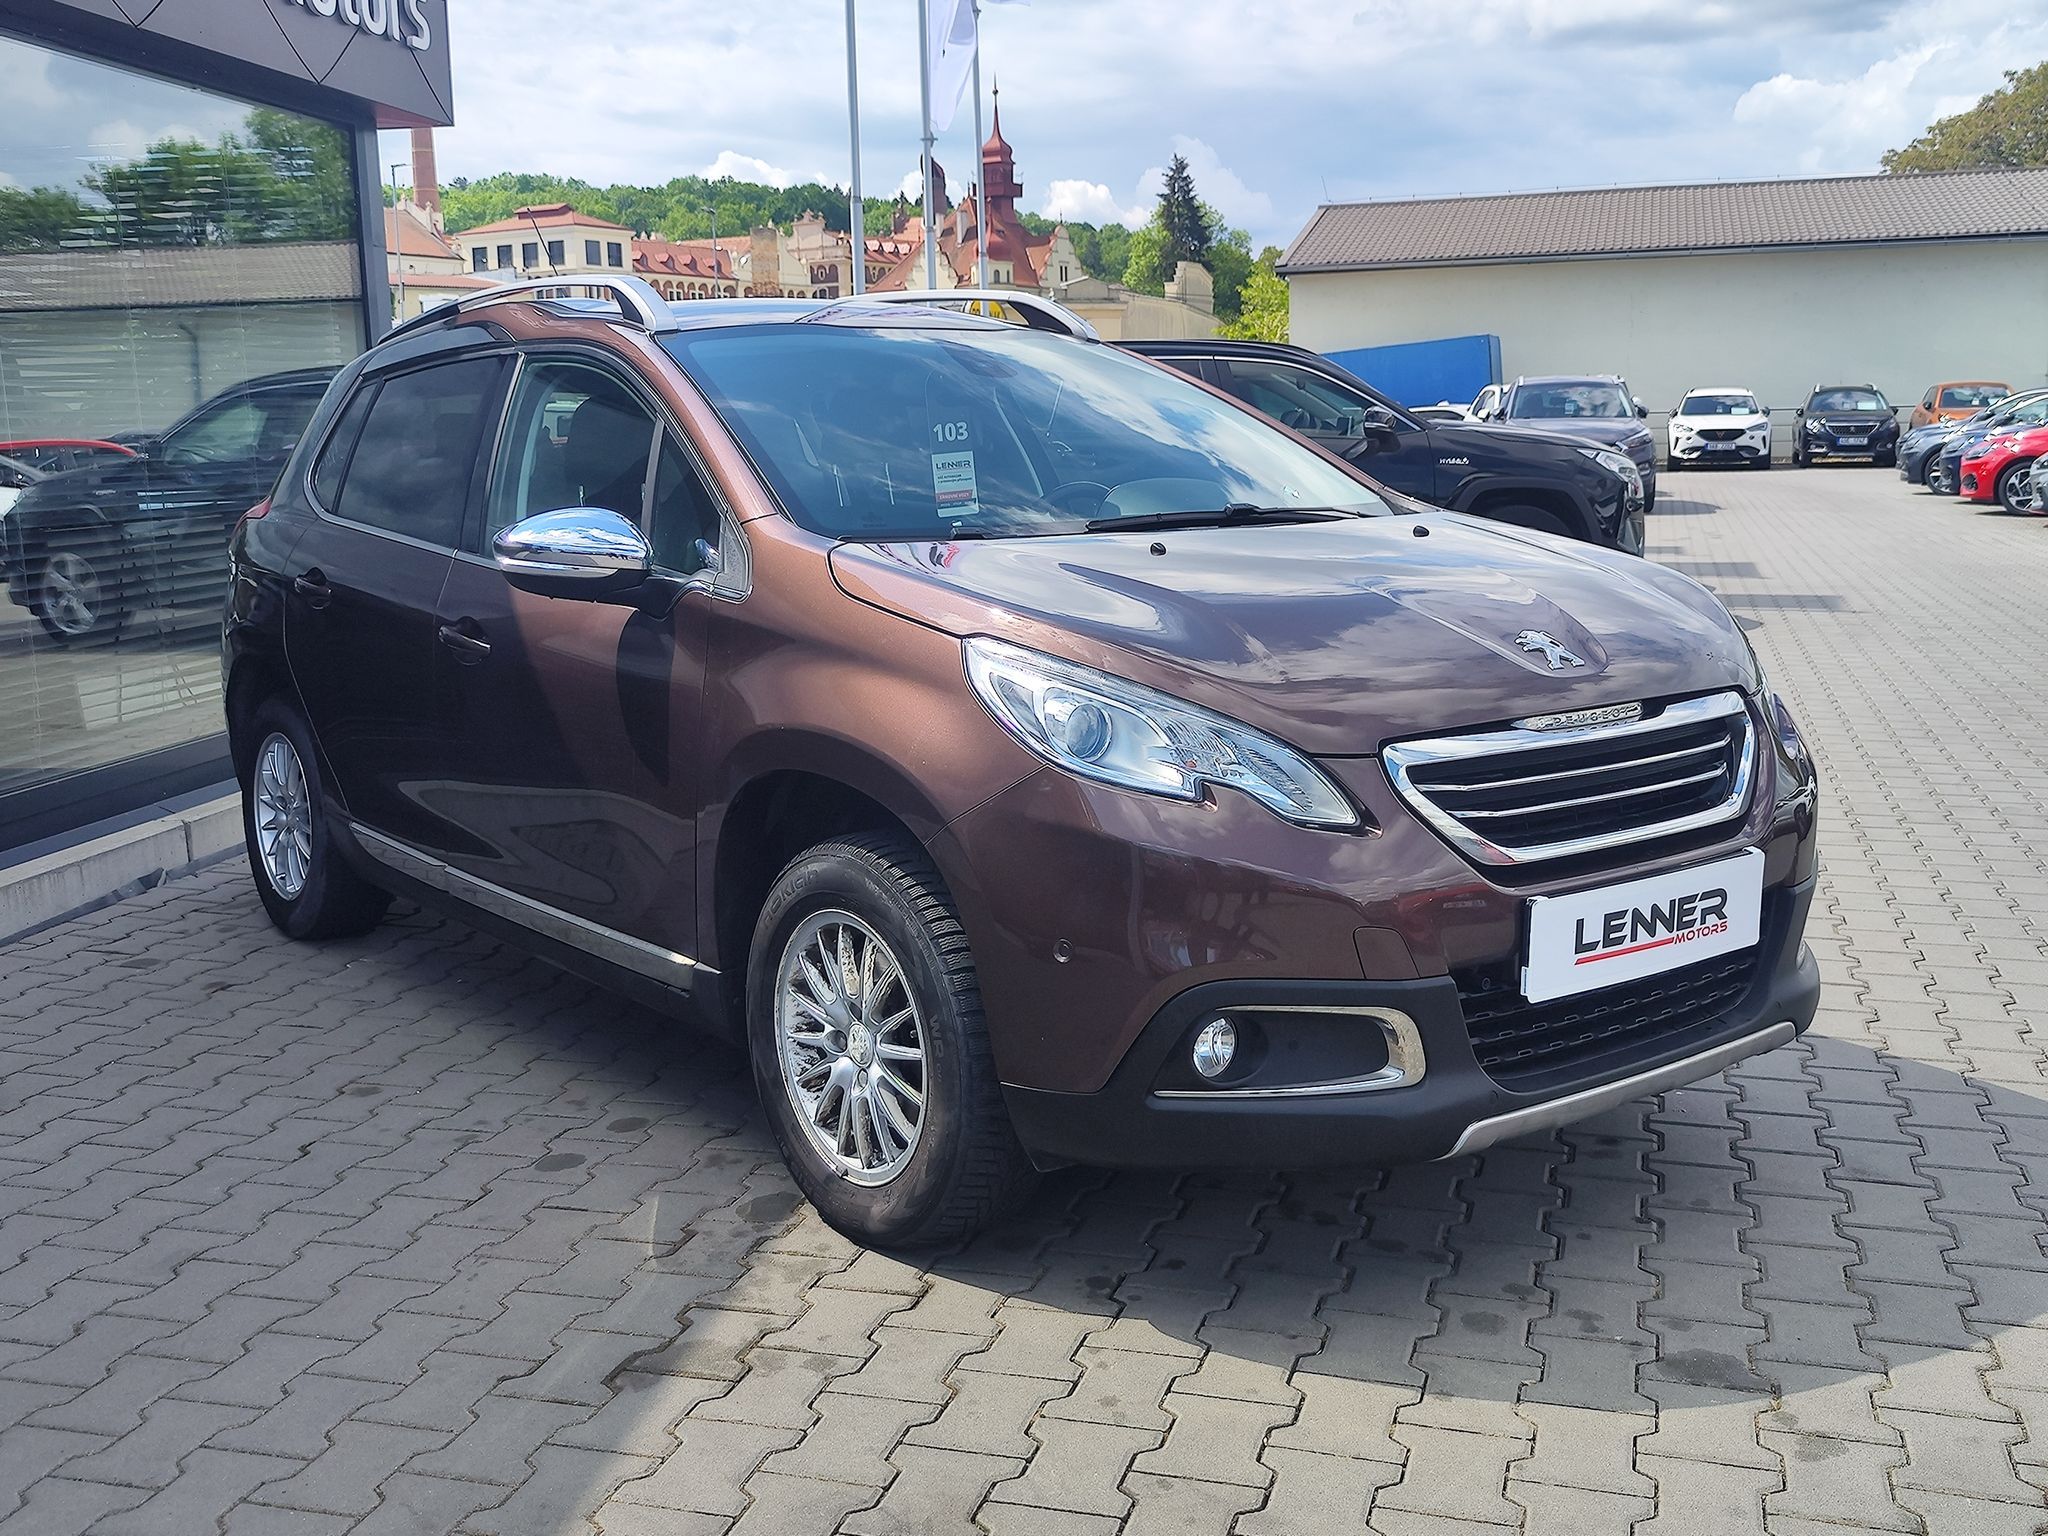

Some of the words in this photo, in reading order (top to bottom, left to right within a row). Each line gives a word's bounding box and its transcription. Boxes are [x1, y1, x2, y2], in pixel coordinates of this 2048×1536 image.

[932, 421, 969, 442] 103
[1574, 887, 1728, 955] LENNER
[1674, 920, 1728, 945] MOTORS
